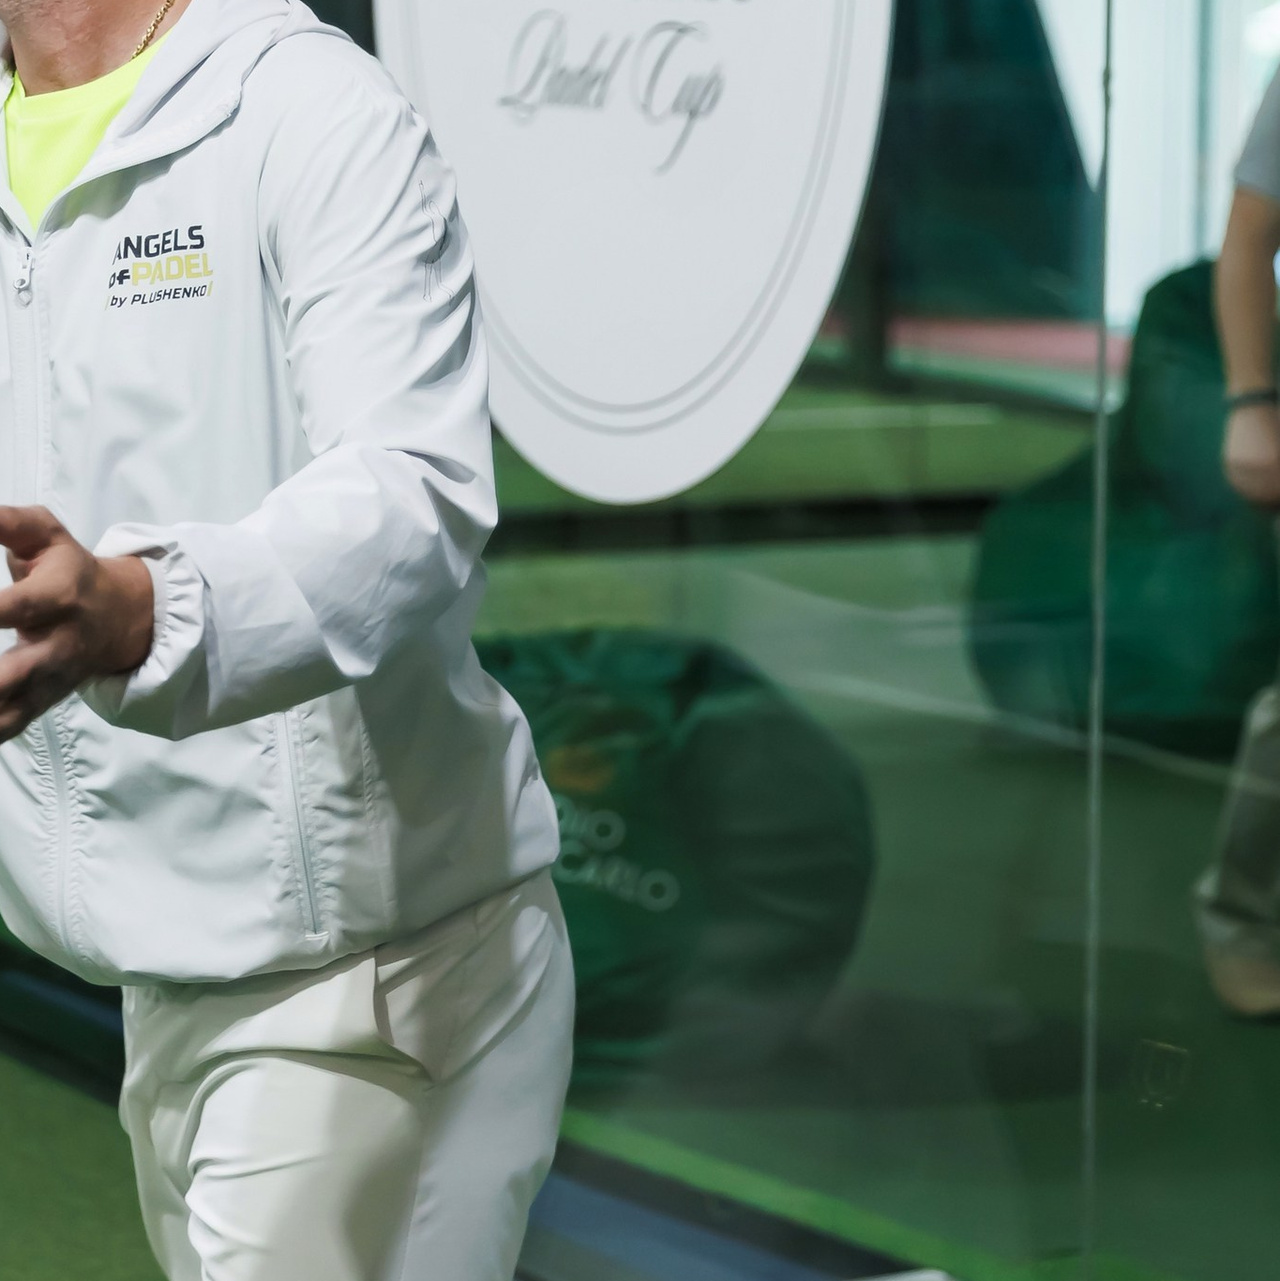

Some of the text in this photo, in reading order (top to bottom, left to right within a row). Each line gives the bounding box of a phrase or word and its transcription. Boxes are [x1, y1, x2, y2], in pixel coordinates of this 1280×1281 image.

[634, 20, 727, 176] Cup
[112, 225, 205, 265] ANGELS
[131, 253, 214, 286] PADEL
[131, 285, 207, 305] PLUSHENKO
